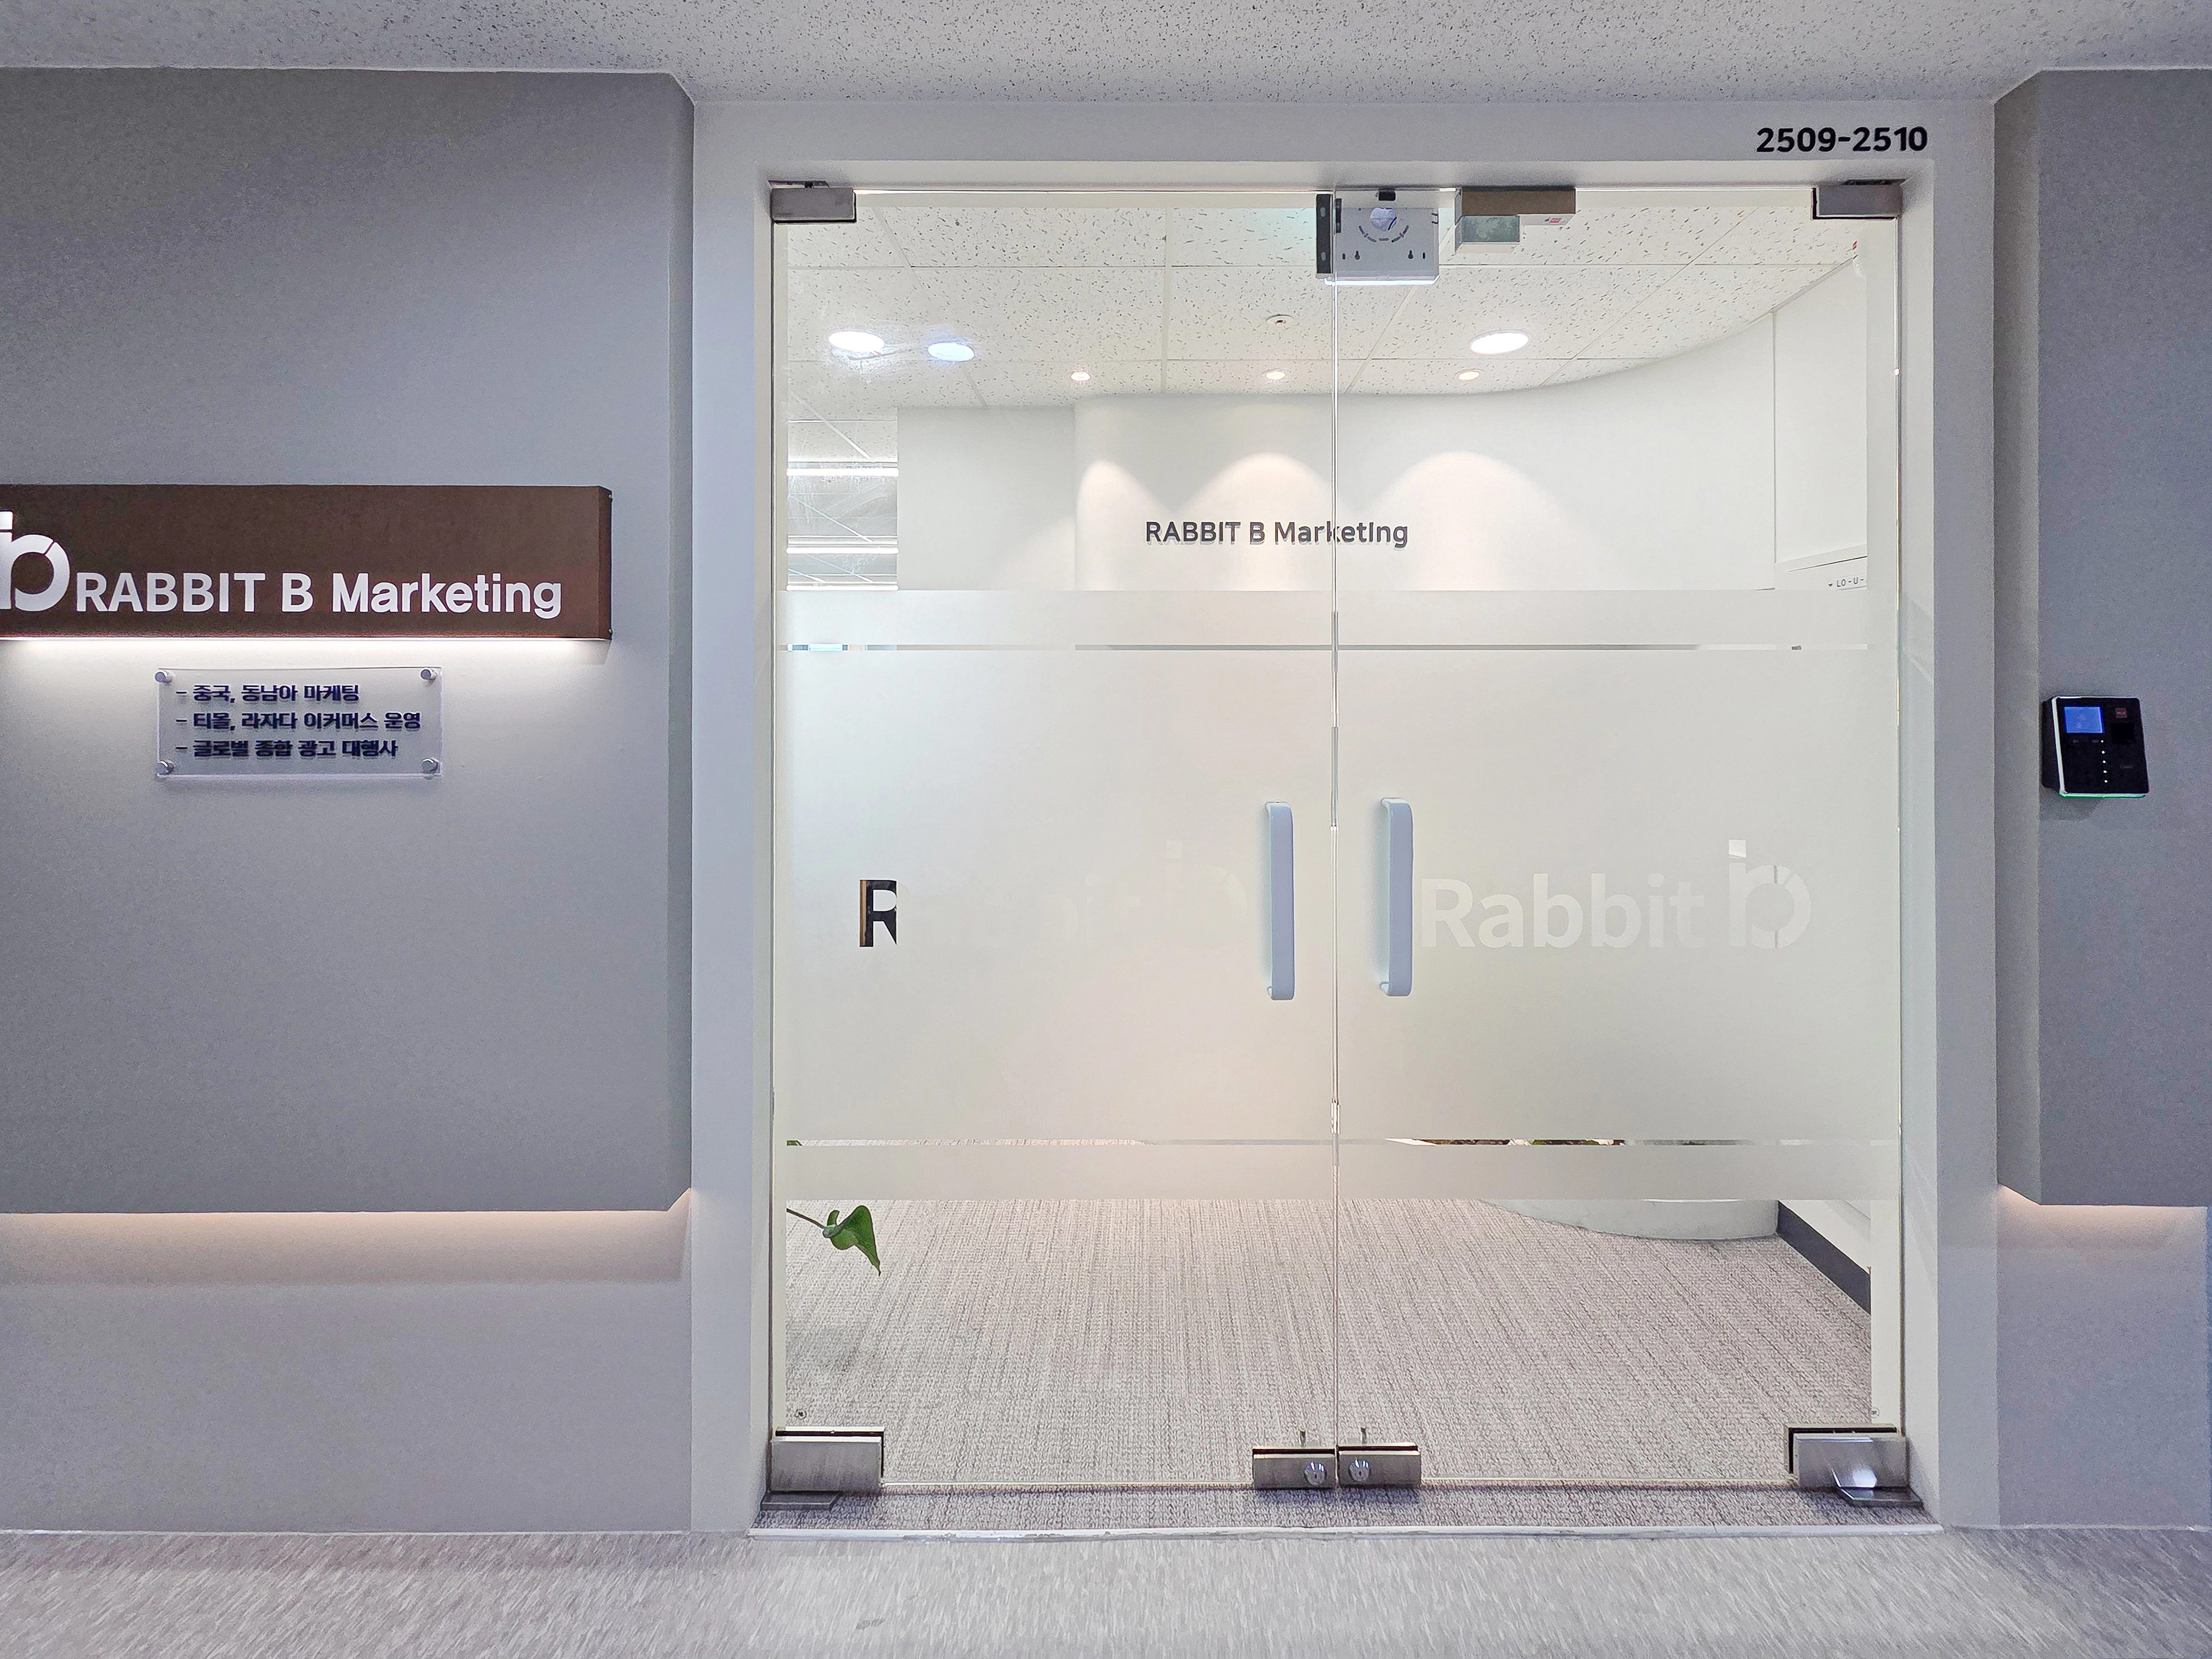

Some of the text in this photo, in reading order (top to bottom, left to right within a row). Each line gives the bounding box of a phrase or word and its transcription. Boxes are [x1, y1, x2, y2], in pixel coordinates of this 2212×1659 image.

[1756, 126, 1928, 152] 2509-2510
[1146, 521, 1408, 549] RABBIT B Marketing
[76, 572, 266, 612] RABBIT
[281, 572, 314, 612] B
[332, 573, 561, 619] Marketing
[193, 685, 359, 703] 중국, 동남아 마케팅
[194, 712, 421, 731] 티몰, 라자다 이커머스 운영
[193, 740, 399, 757] 글로벌 종합 광고 대행사
[1421, 873, 1705, 949] Rabbit
